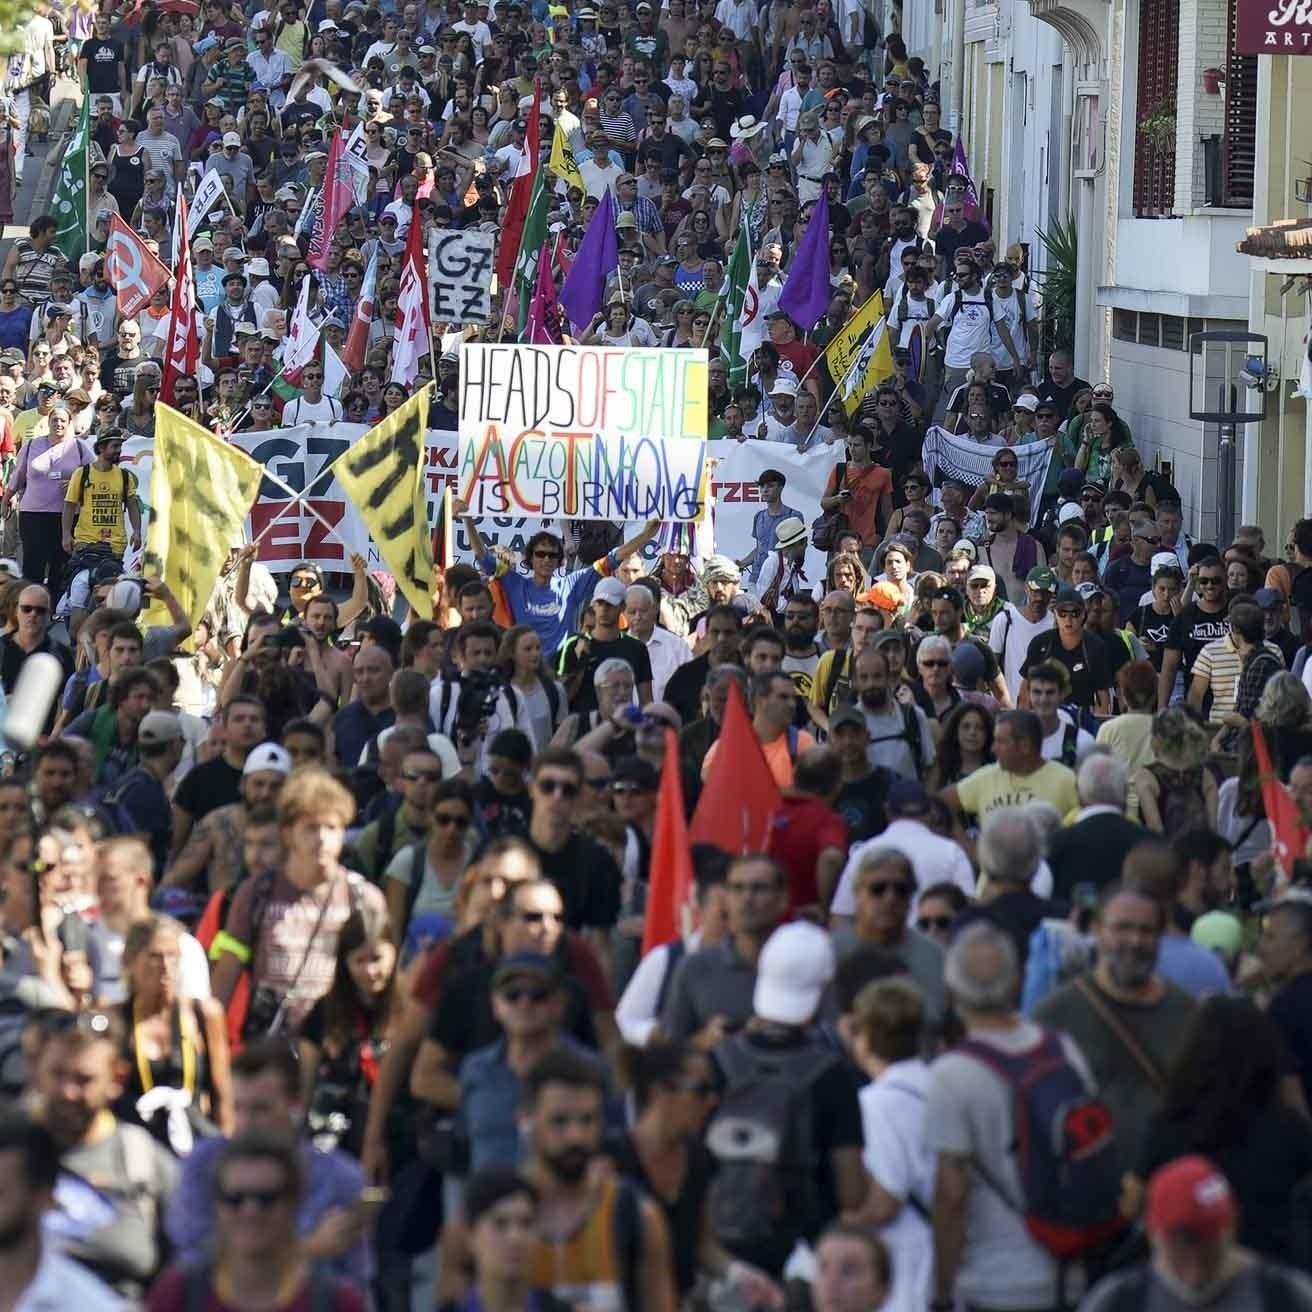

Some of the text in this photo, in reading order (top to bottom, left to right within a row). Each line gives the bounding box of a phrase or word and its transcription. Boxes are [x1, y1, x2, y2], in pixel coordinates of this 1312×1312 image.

[436, 234, 492, 283] G7
[433, 282, 487, 321] EZ
[461, 347, 706, 439] HEADS OF STATE
[250, 438, 350, 500] G7
[479, 476, 706, 520] IS BURNING
[250, 500, 347, 562] EZ
